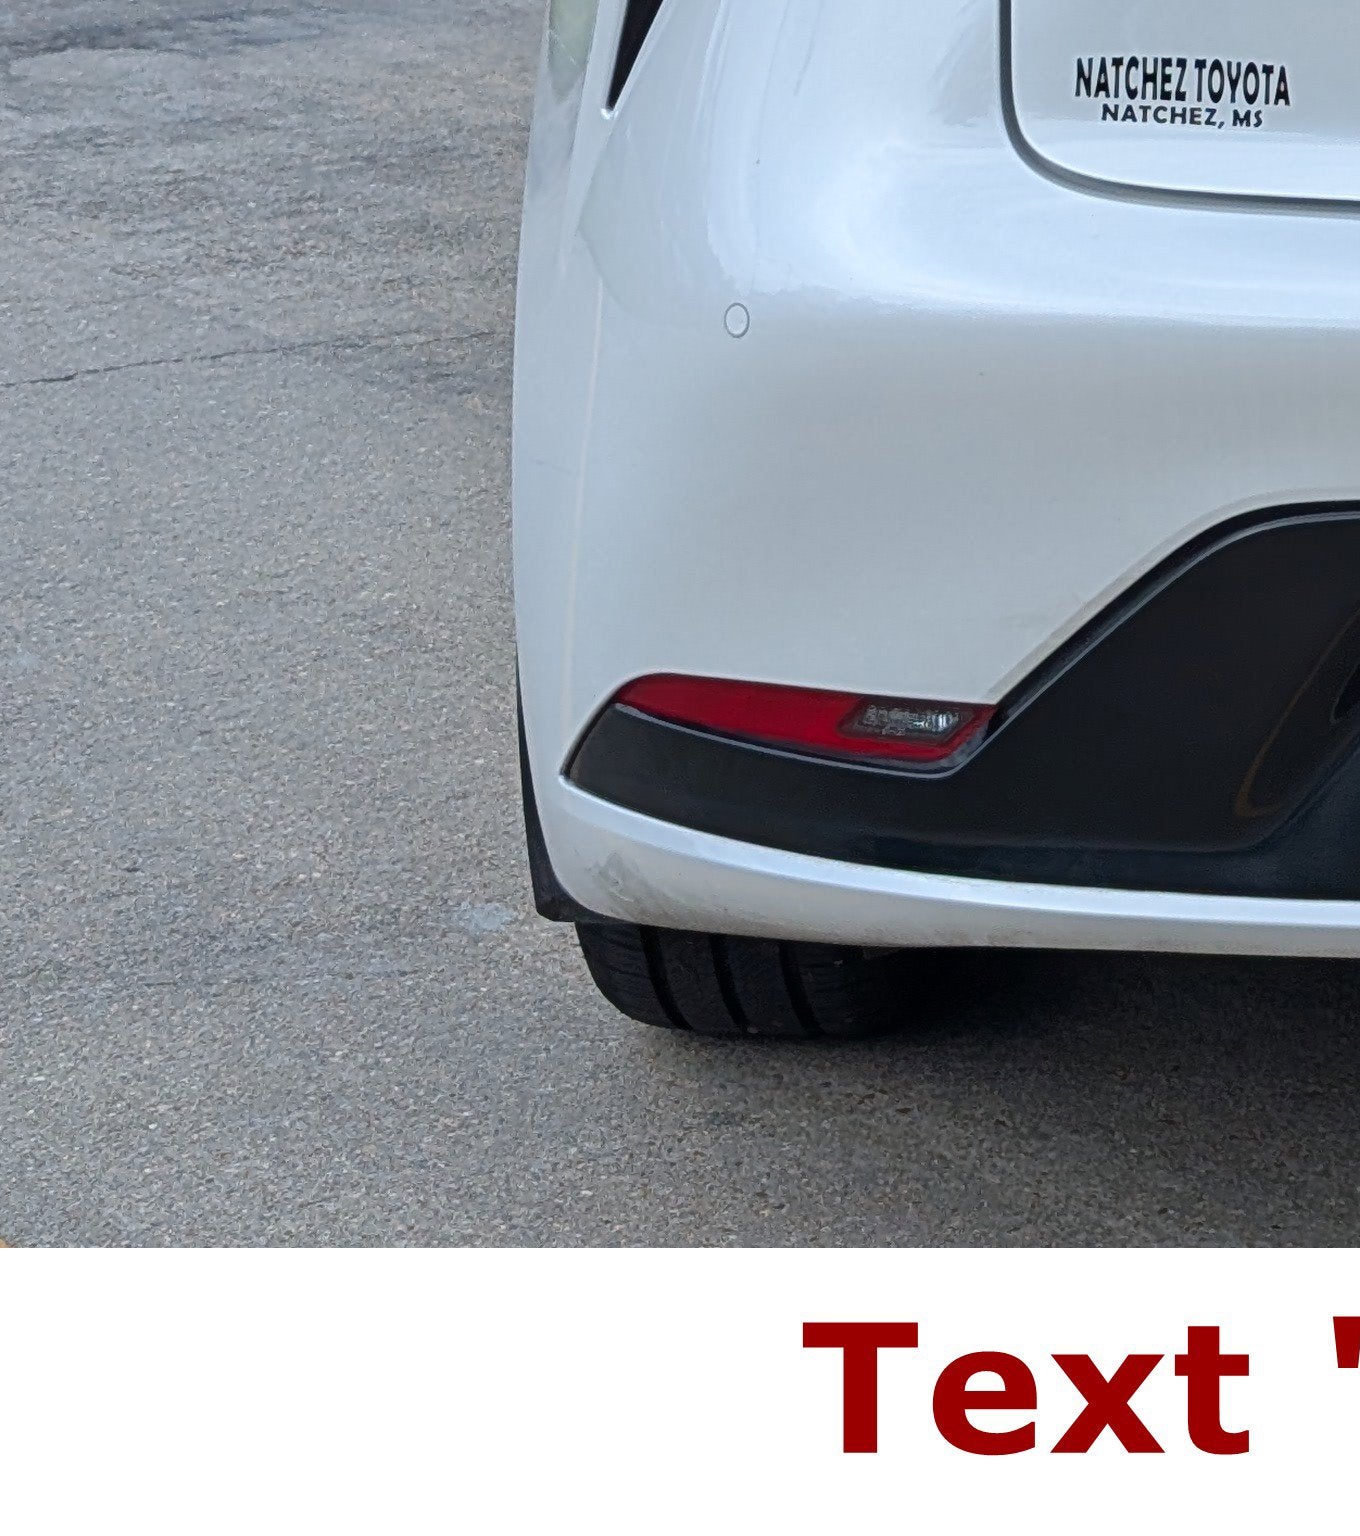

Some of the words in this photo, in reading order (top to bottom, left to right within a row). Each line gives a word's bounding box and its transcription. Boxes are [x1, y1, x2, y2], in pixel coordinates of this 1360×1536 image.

[1075, 55, 1187, 102] NATCHEZ
[1194, 58, 1291, 106] TOYOTA
[1101, 103, 1225, 129] NATCHEZ,
[1232, 109, 1263, 128] MS
